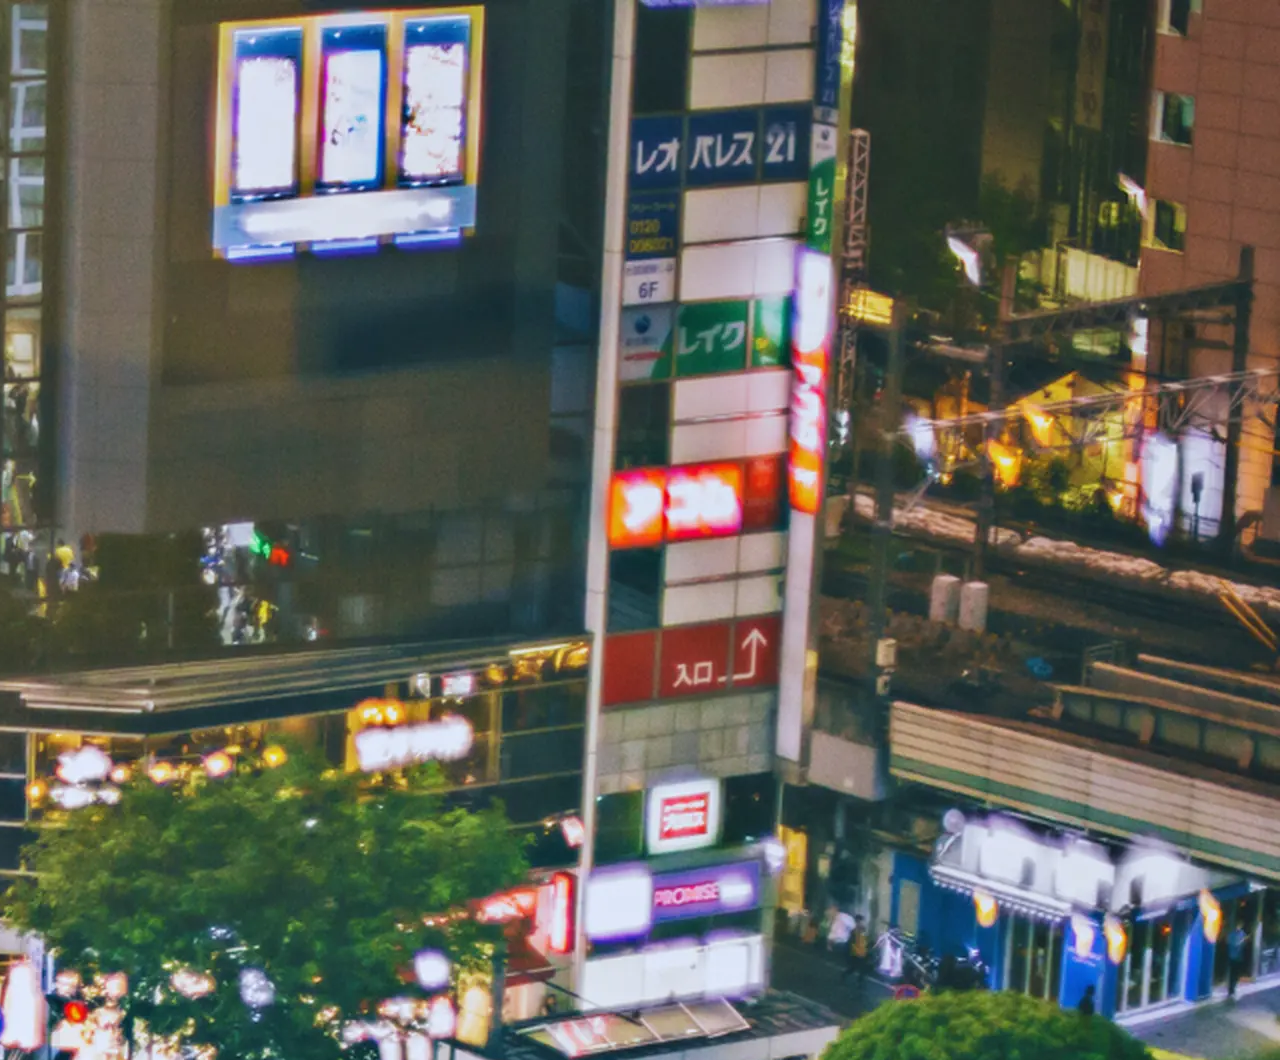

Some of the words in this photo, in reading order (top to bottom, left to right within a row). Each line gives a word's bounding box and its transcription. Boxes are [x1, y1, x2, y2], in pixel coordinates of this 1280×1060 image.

[813, 177, 829, 236] レイク
[639, 281, 658, 298] 6F
[679, 321, 746, 354] レイク
[672, 661, 713, 688] 入口
[653, 881, 720, 907] PROMISE
